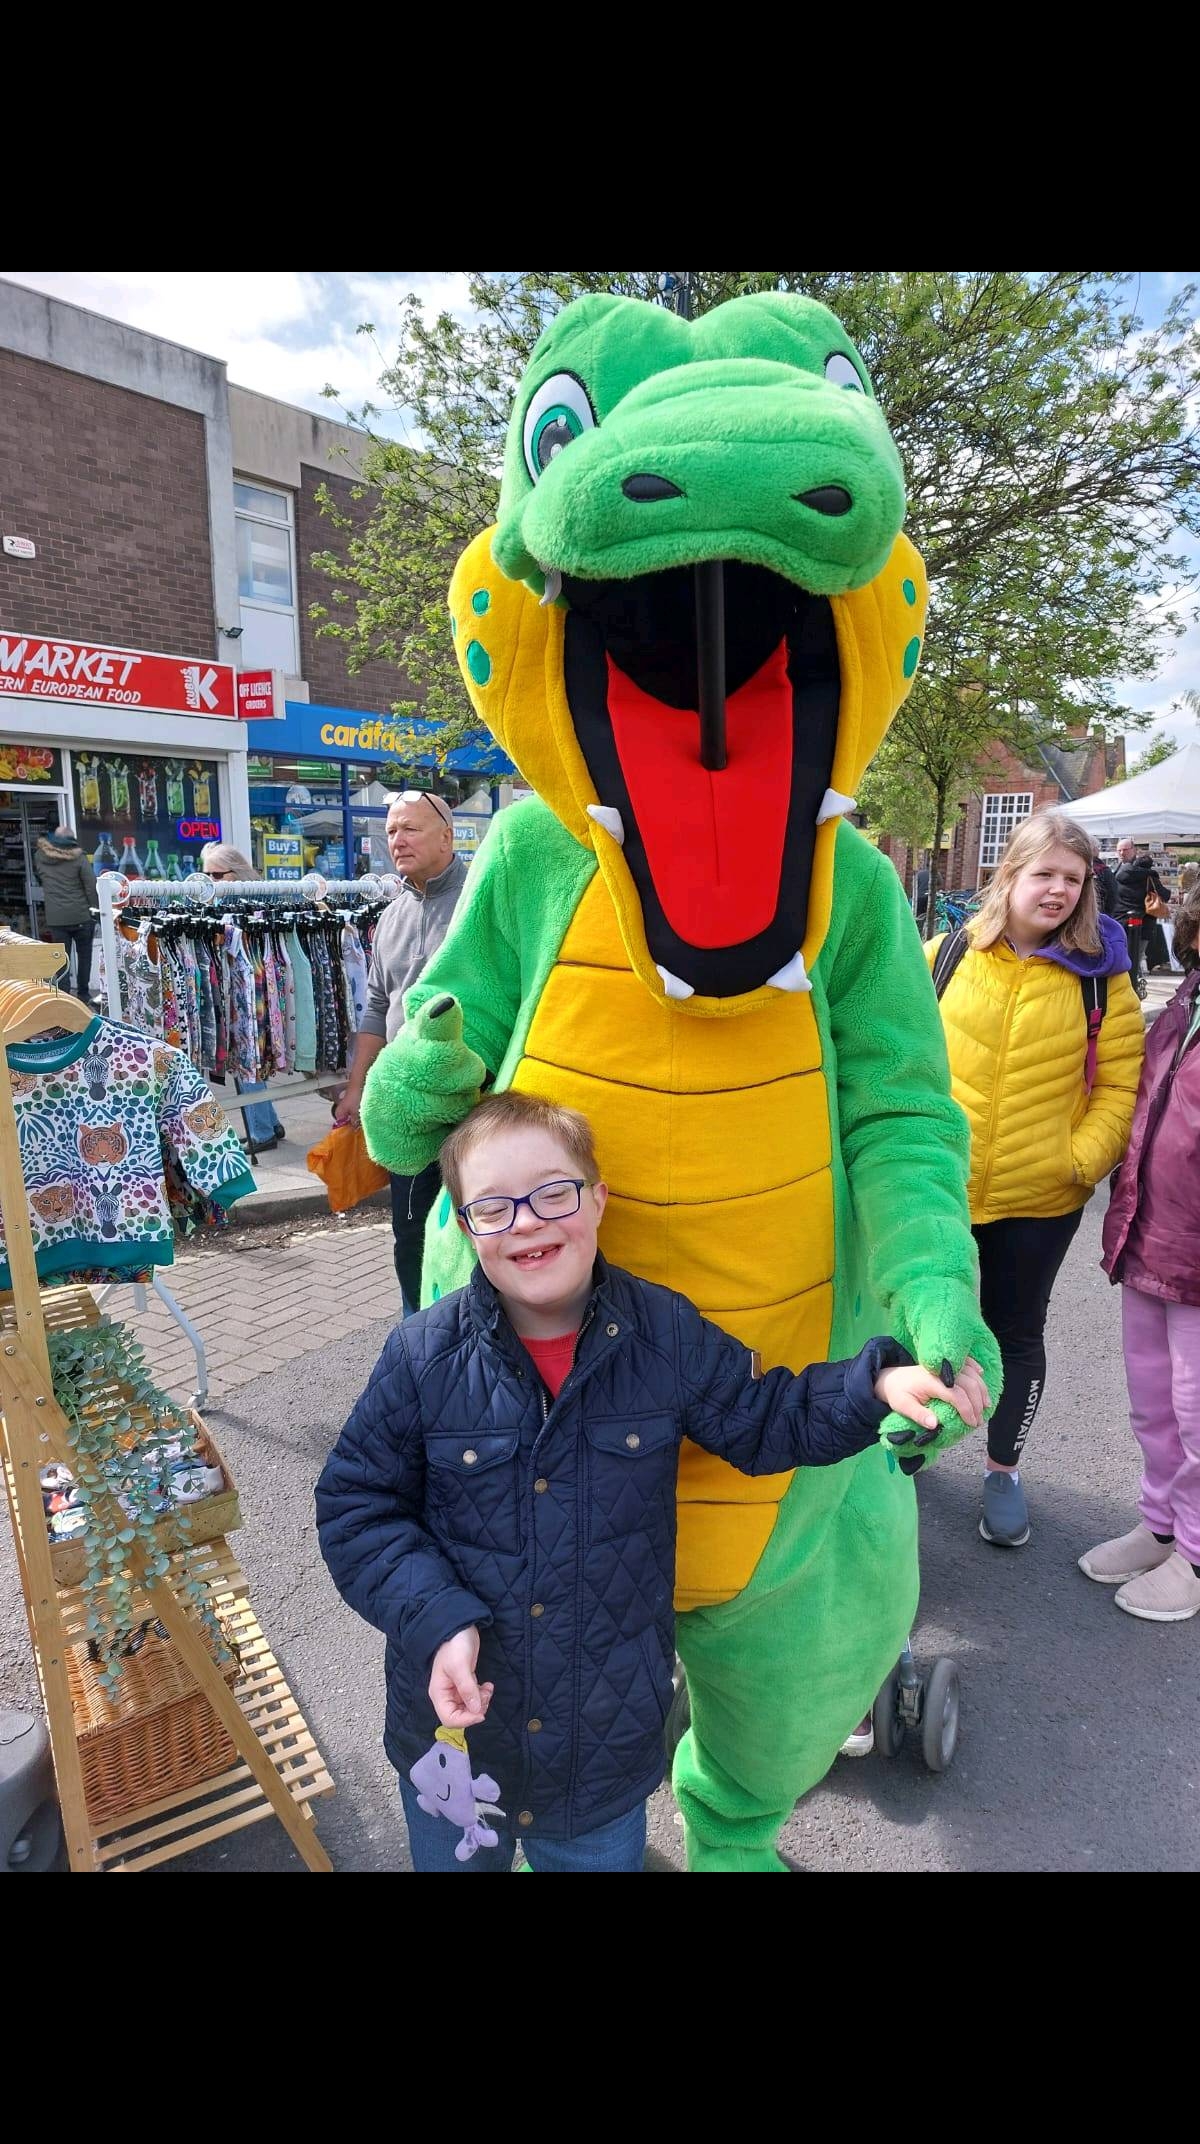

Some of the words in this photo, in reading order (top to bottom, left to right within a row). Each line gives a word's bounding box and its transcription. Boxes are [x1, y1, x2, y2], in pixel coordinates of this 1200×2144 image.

[0, 638, 142, 686] MARKET
[30, 679, 104, 699] EUROPEAN
[106, 688, 141, 703] FOOD
[180, 821, 219, 838] OPEN
[268, 840, 291, 854] Buy
[292, 840, 299, 851] 3
[278, 867, 299, 879] free
[1013, 1380, 1040, 1451] MOTIVATE
